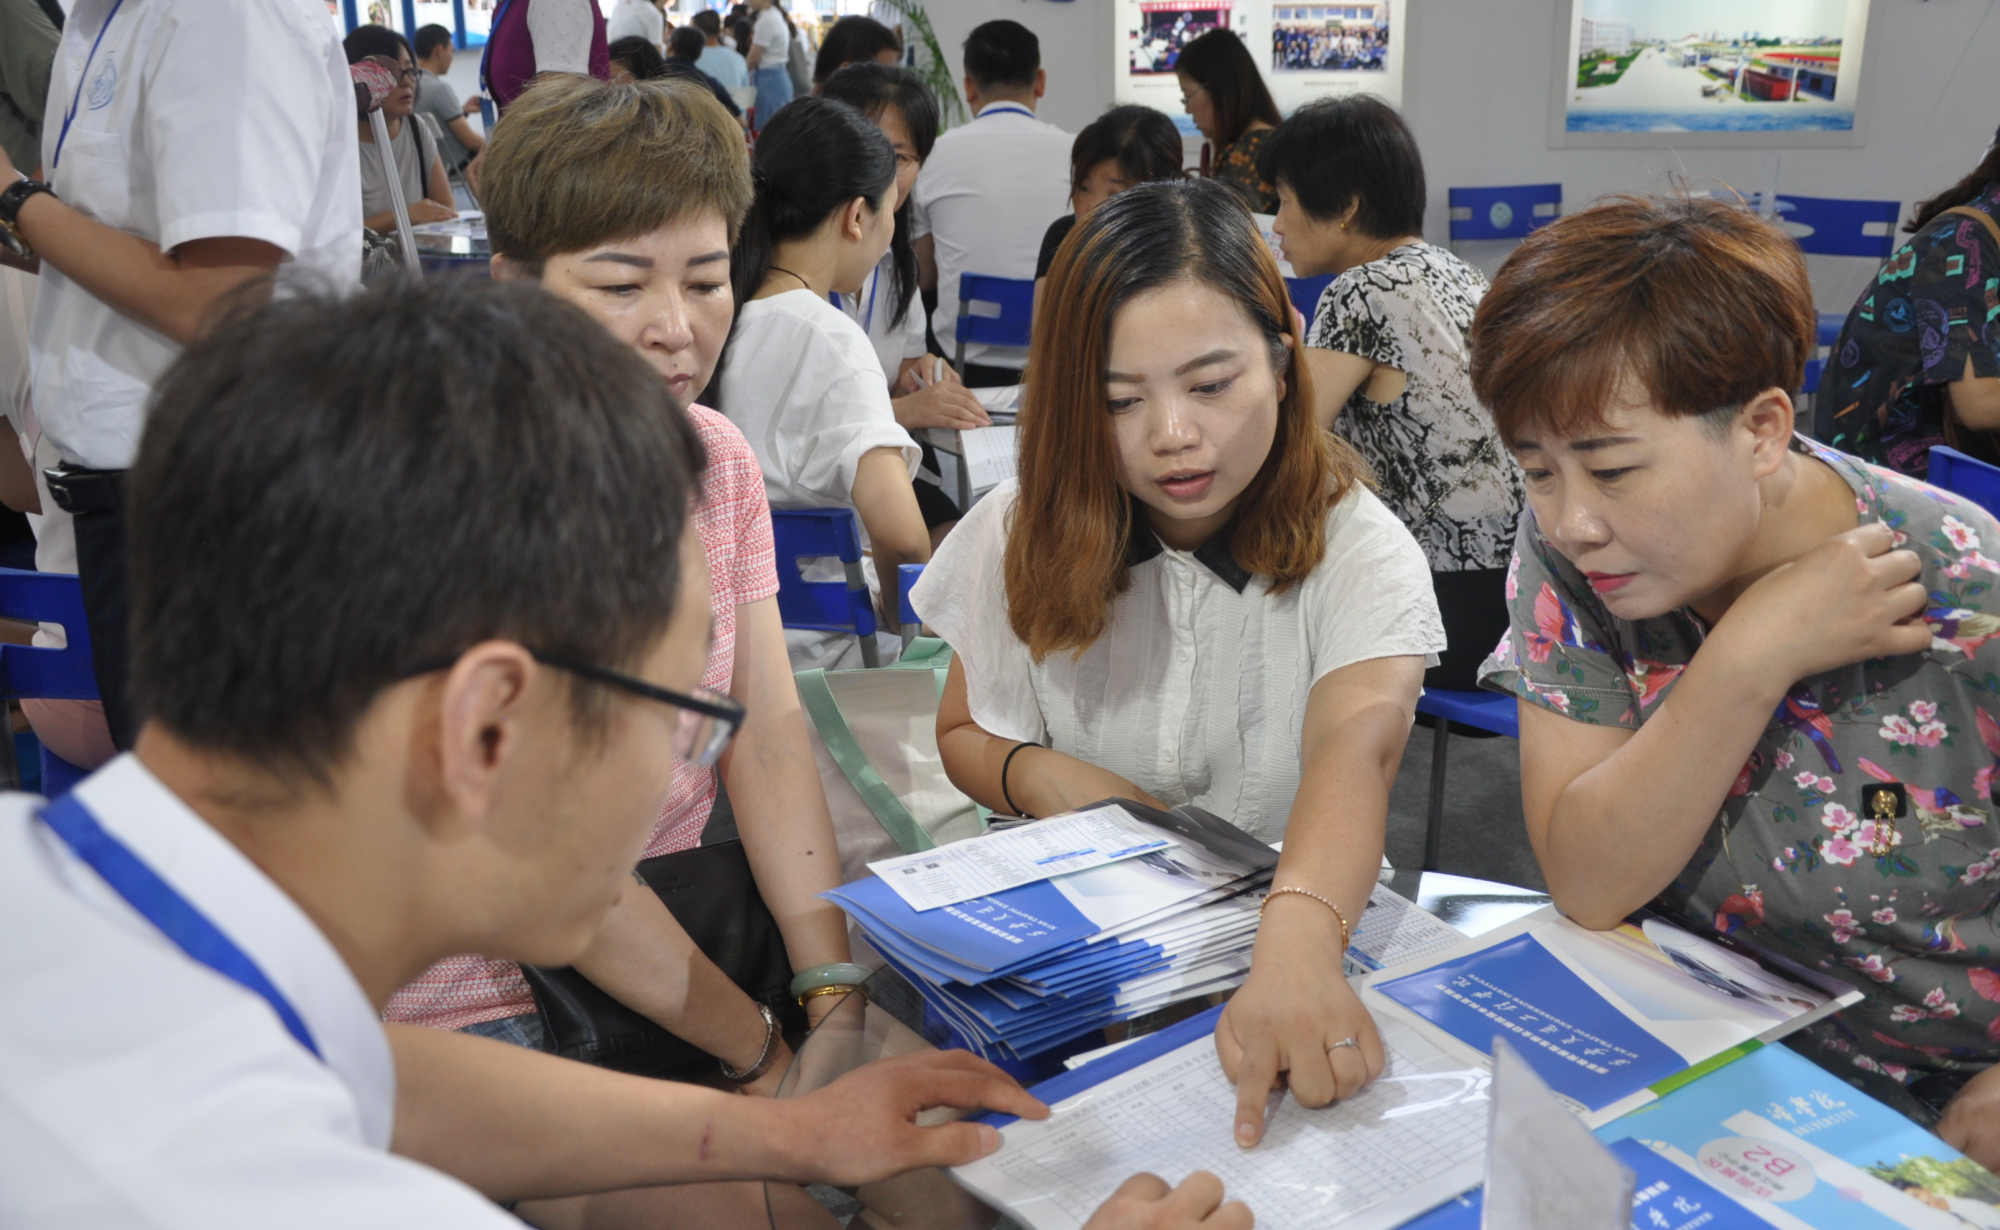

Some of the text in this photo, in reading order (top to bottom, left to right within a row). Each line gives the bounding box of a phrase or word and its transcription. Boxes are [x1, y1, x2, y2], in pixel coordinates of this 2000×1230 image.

[1008, 908, 1038, 923] TRAFFIC
[1467, 973, 1513, 999] INSTITUTE
[1512, 997, 1573, 1029] ENGINEERING
[1573, 1028, 1613, 1049] TRAFFIC
[1791, 1110, 1858, 1136] UNIVERSITY
[1743, 1145, 1796, 1176] B2
